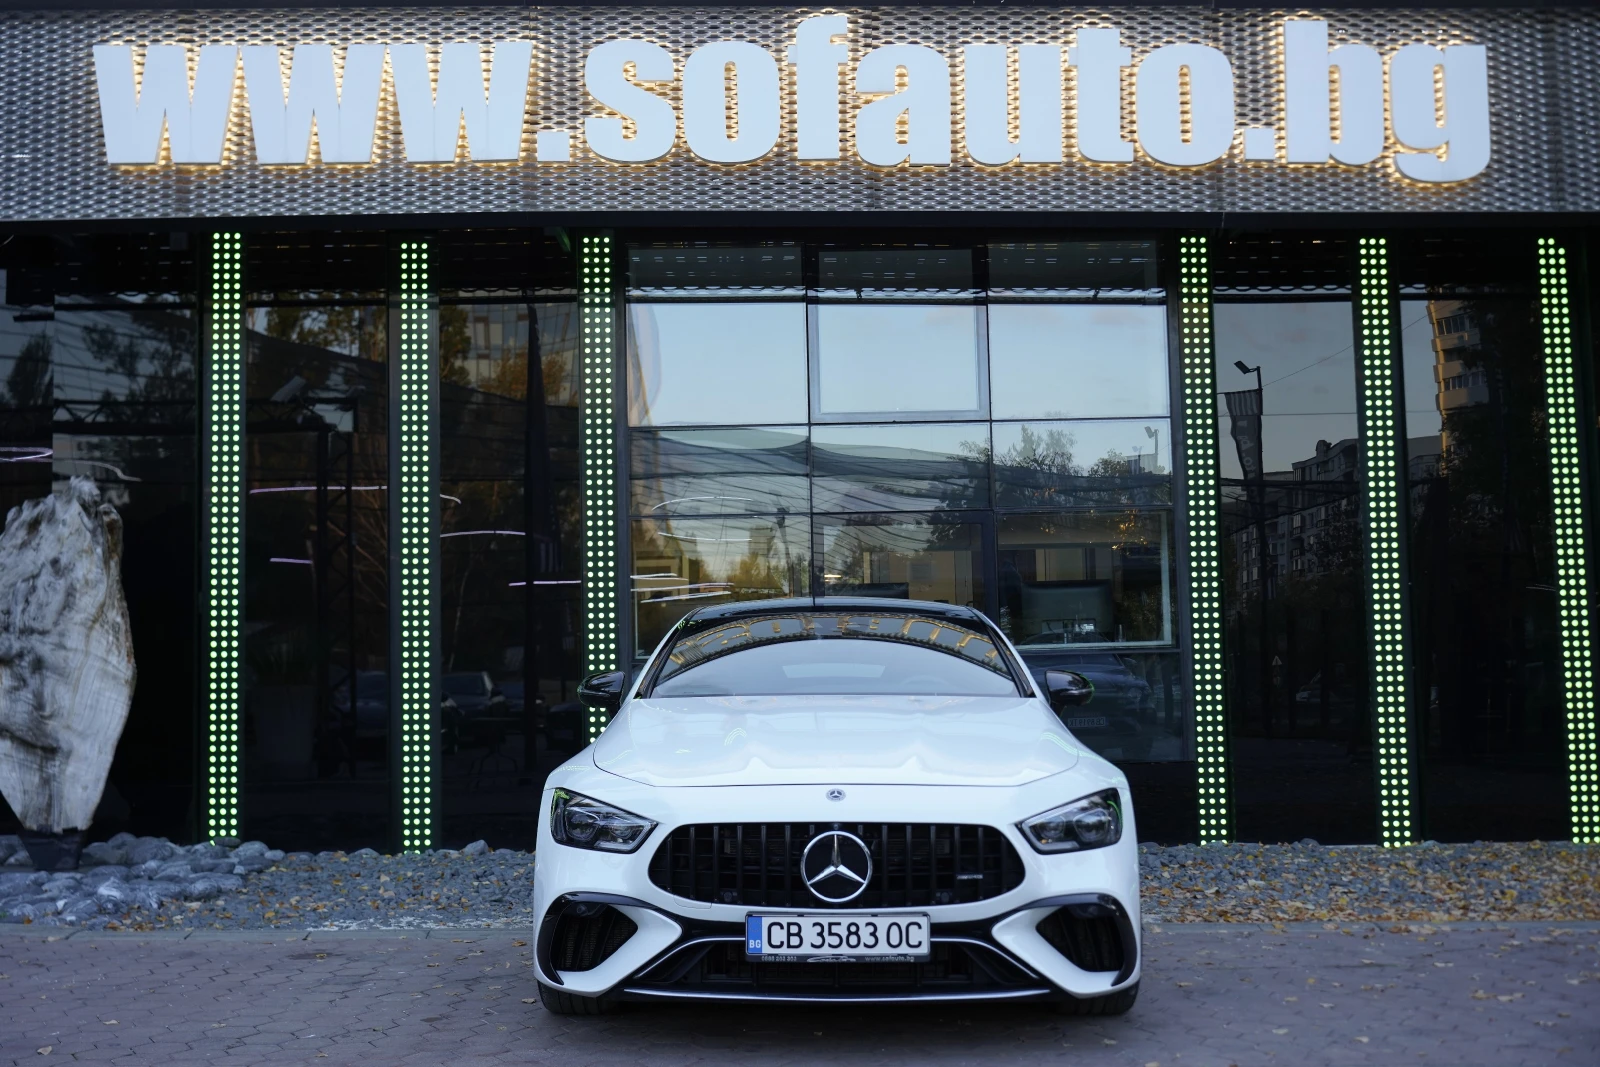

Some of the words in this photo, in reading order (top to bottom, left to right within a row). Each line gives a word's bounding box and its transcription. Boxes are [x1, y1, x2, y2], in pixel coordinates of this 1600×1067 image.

[92, 13, 1491, 183] www.sofauto.bg
[749, 939, 761, 948] BG
[767, 922, 803, 949] CB
[810, 922, 879, 949] 3583
